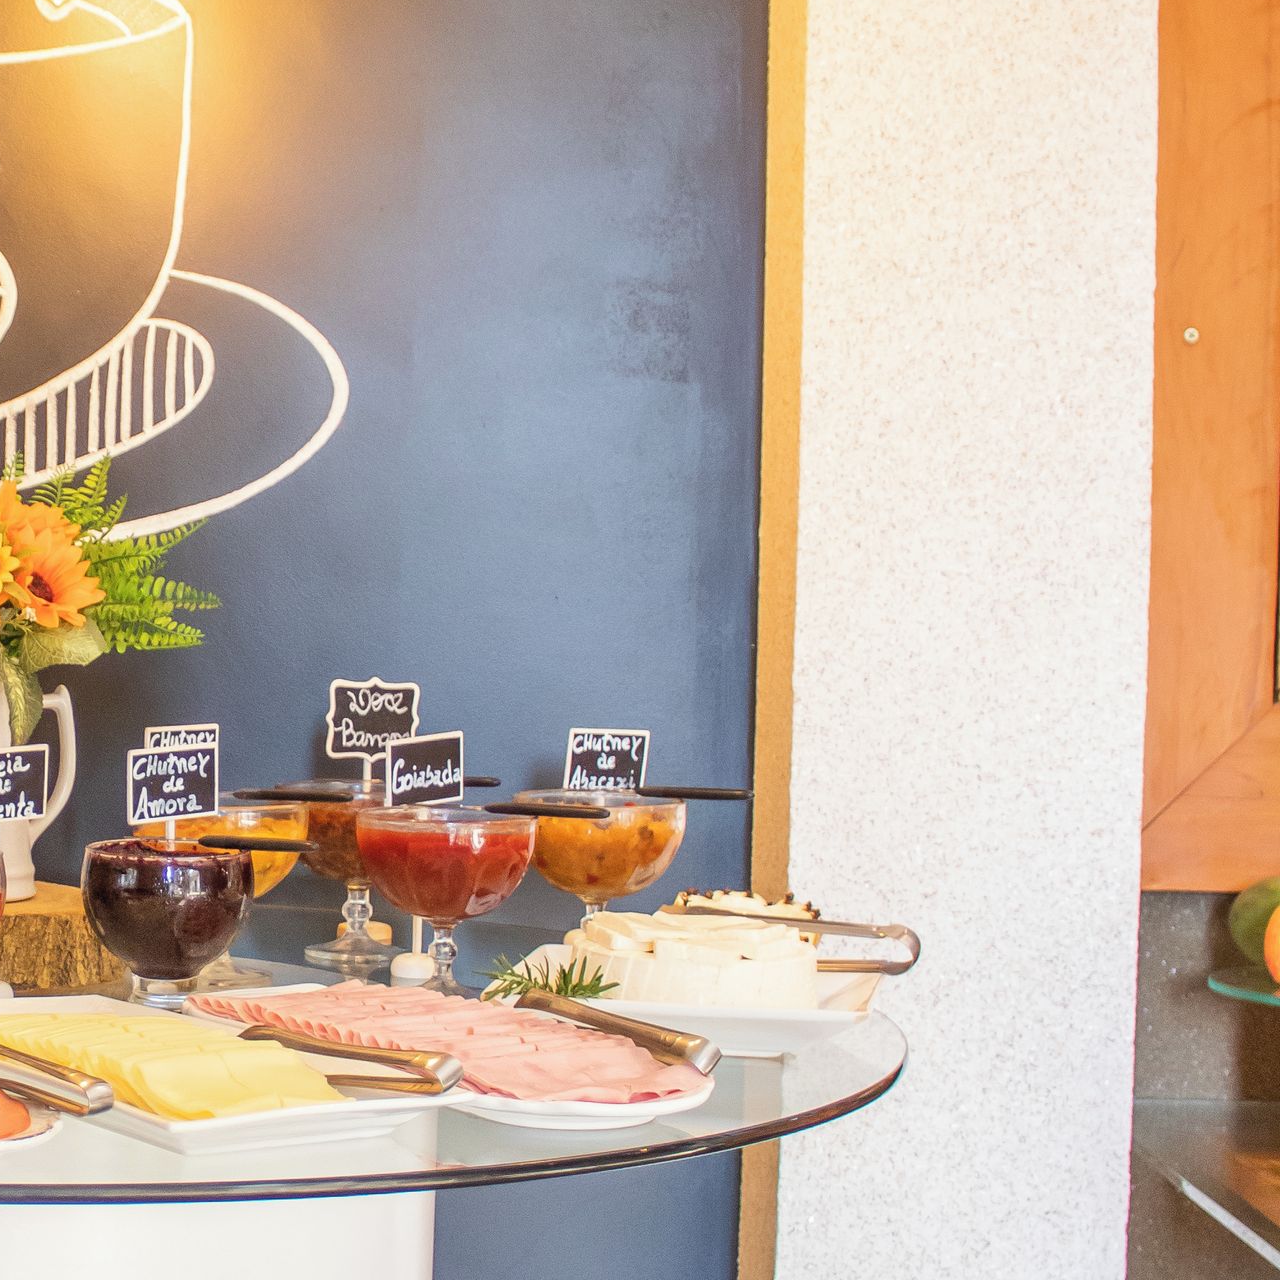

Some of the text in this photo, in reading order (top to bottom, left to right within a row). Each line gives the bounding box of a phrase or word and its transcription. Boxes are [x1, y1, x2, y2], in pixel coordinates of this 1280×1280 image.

[597, 752, 616, 770] de
[162, 775, 185, 793] de
[392, 758, 462, 794] Goiabada
[569, 764, 636, 790] Abacaxi
[133, 786, 203, 820] Amora
